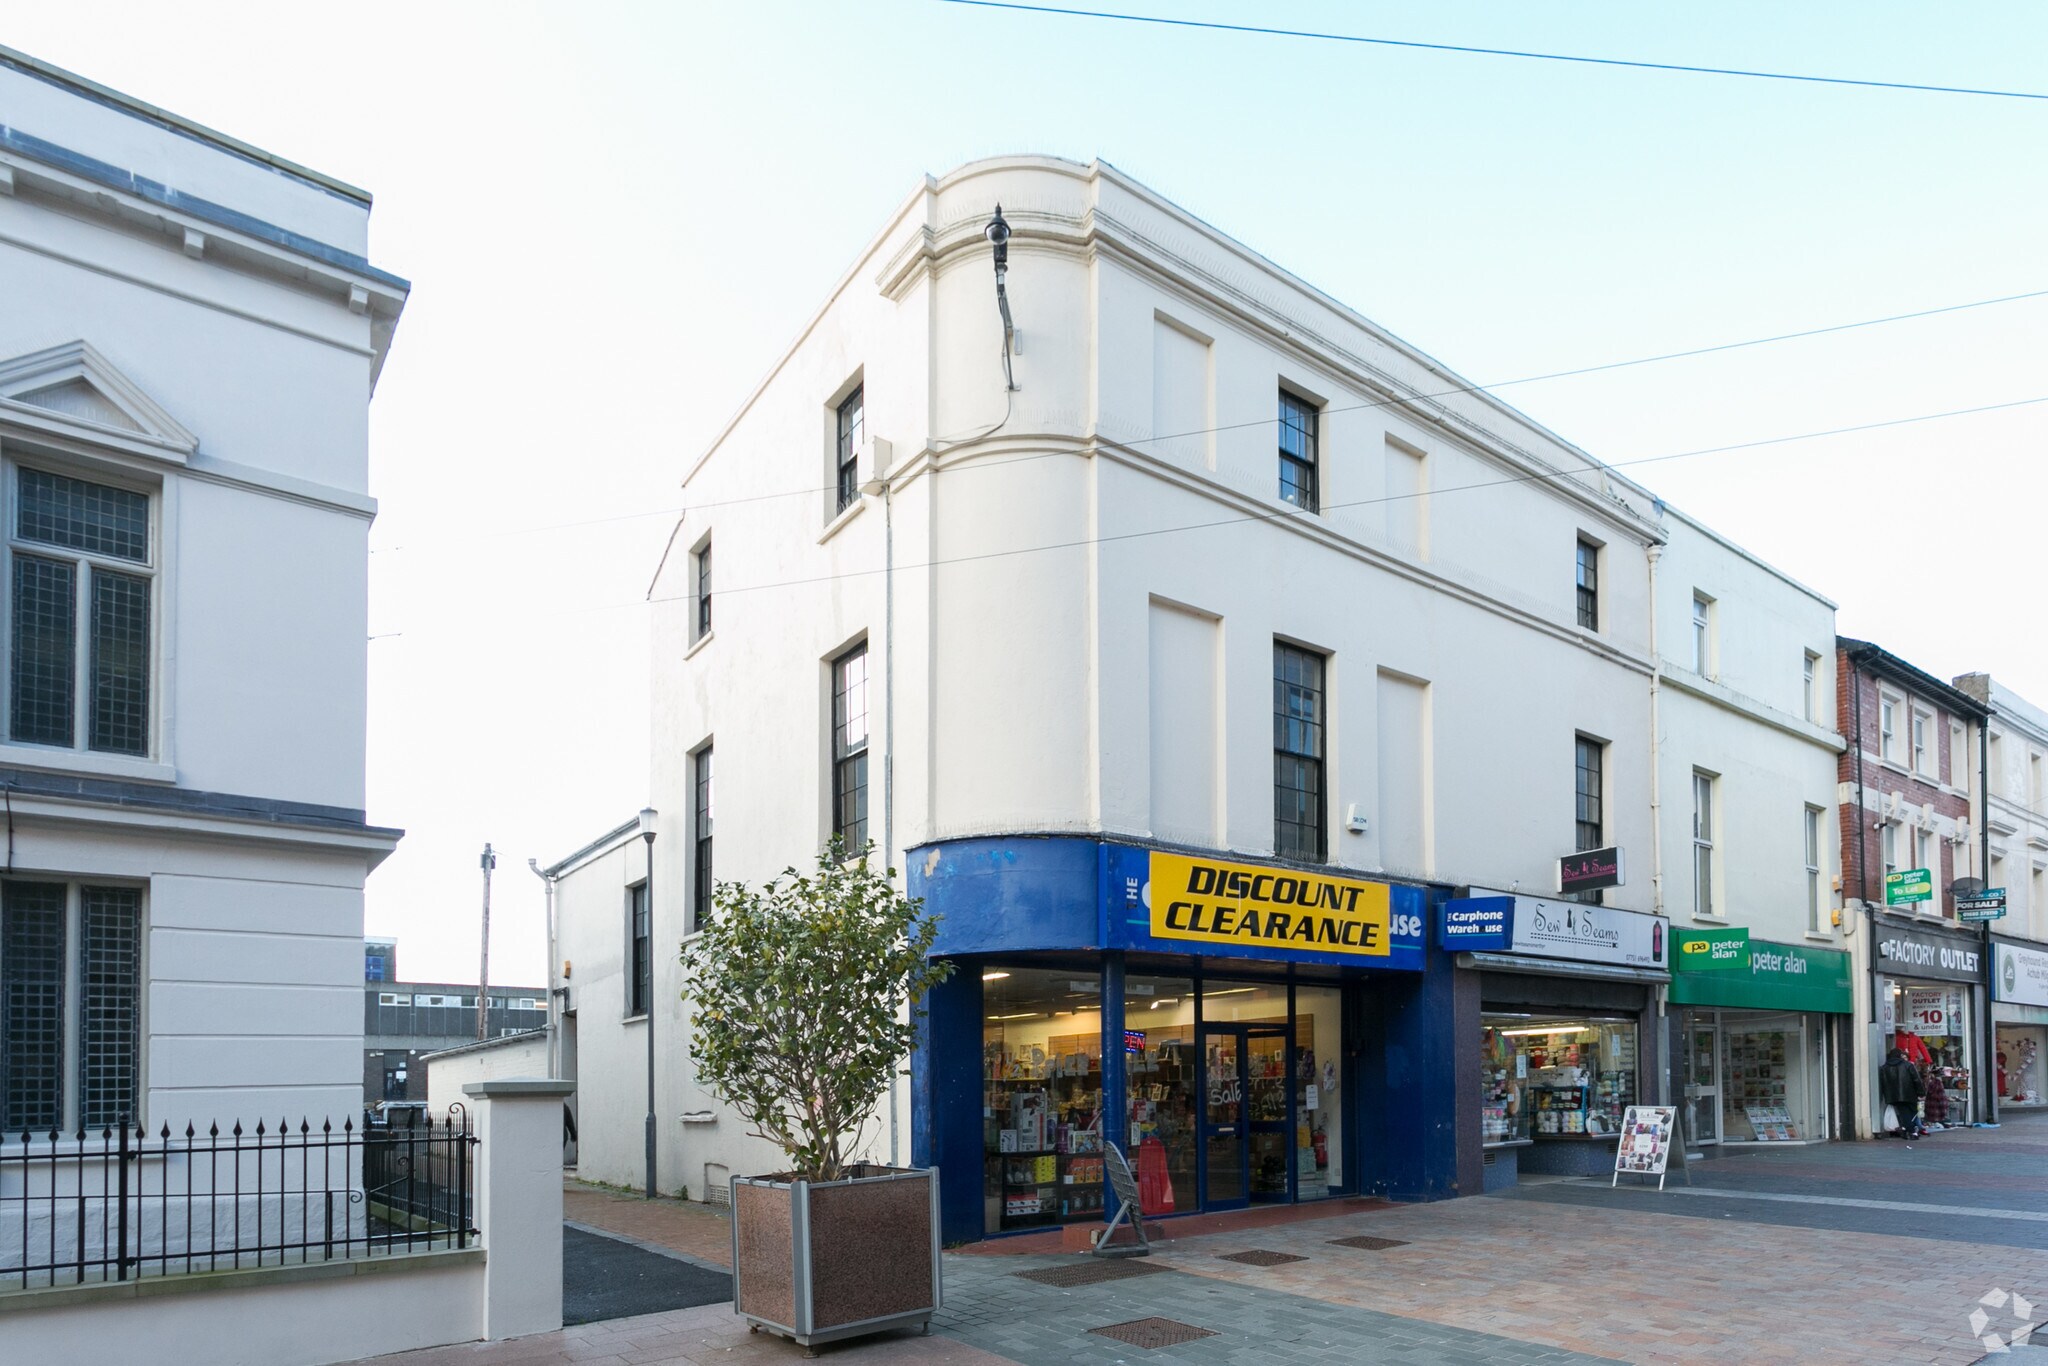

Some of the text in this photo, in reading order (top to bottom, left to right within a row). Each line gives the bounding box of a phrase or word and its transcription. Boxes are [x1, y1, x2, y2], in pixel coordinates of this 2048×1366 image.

[1186, 865, 1365, 912] DISCOUNT
[1975, 900, 1998, 908] SALE
[1164, 901, 1380, 948] CLEARANCE
[1452, 911, 1504, 923] Carphone
[1532, 903, 1560, 932] Sew
[1581, 910, 1619, 941] Seams
[1447, 924, 1503, 934] Warehuse
[1691, 940, 1745, 952] pa peter
[1711, 949, 1738, 959] alan
[1888, 939, 1979, 973] FACTORY OUTLET
[1752, 951, 1807, 974] peter alan
[1124, 1035, 1145, 1050] PEN
